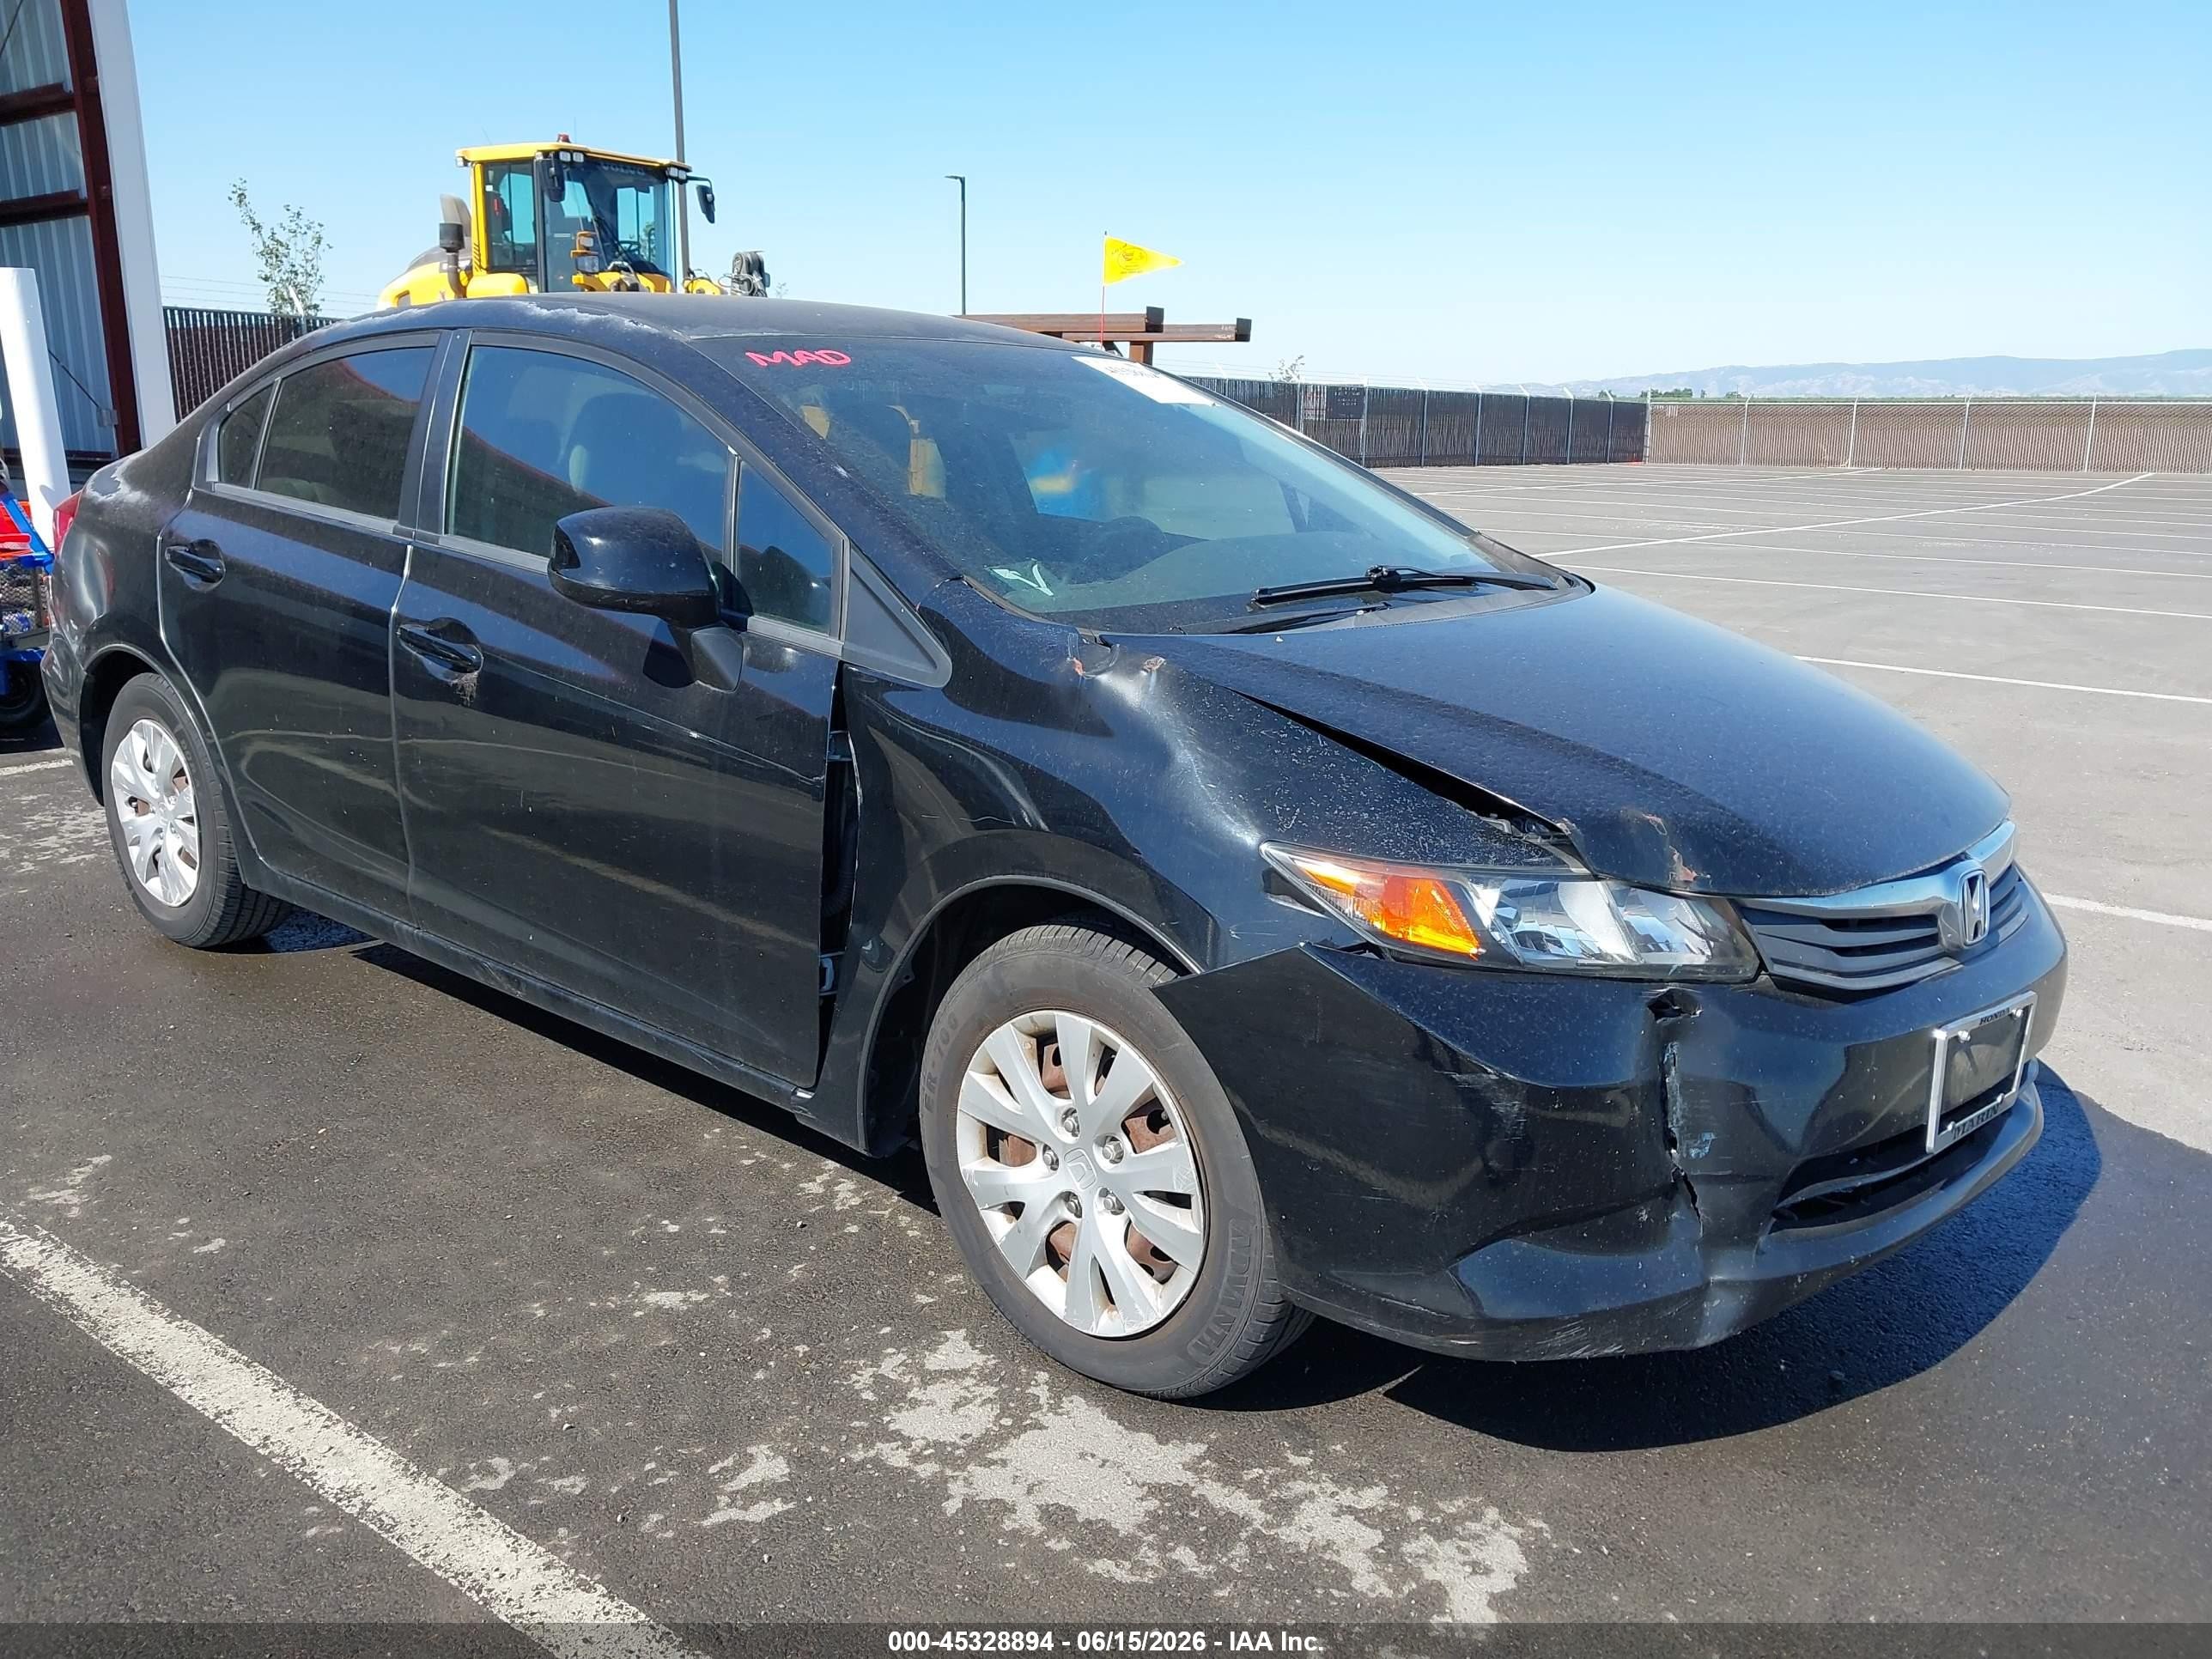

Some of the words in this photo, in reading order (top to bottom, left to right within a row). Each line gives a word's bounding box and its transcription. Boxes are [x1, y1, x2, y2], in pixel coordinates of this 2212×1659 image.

[744, 349, 851, 367] MAD
[1978, 1006, 2010, 1025] HONDA
[1951, 1102, 2000, 1140] MARIN
